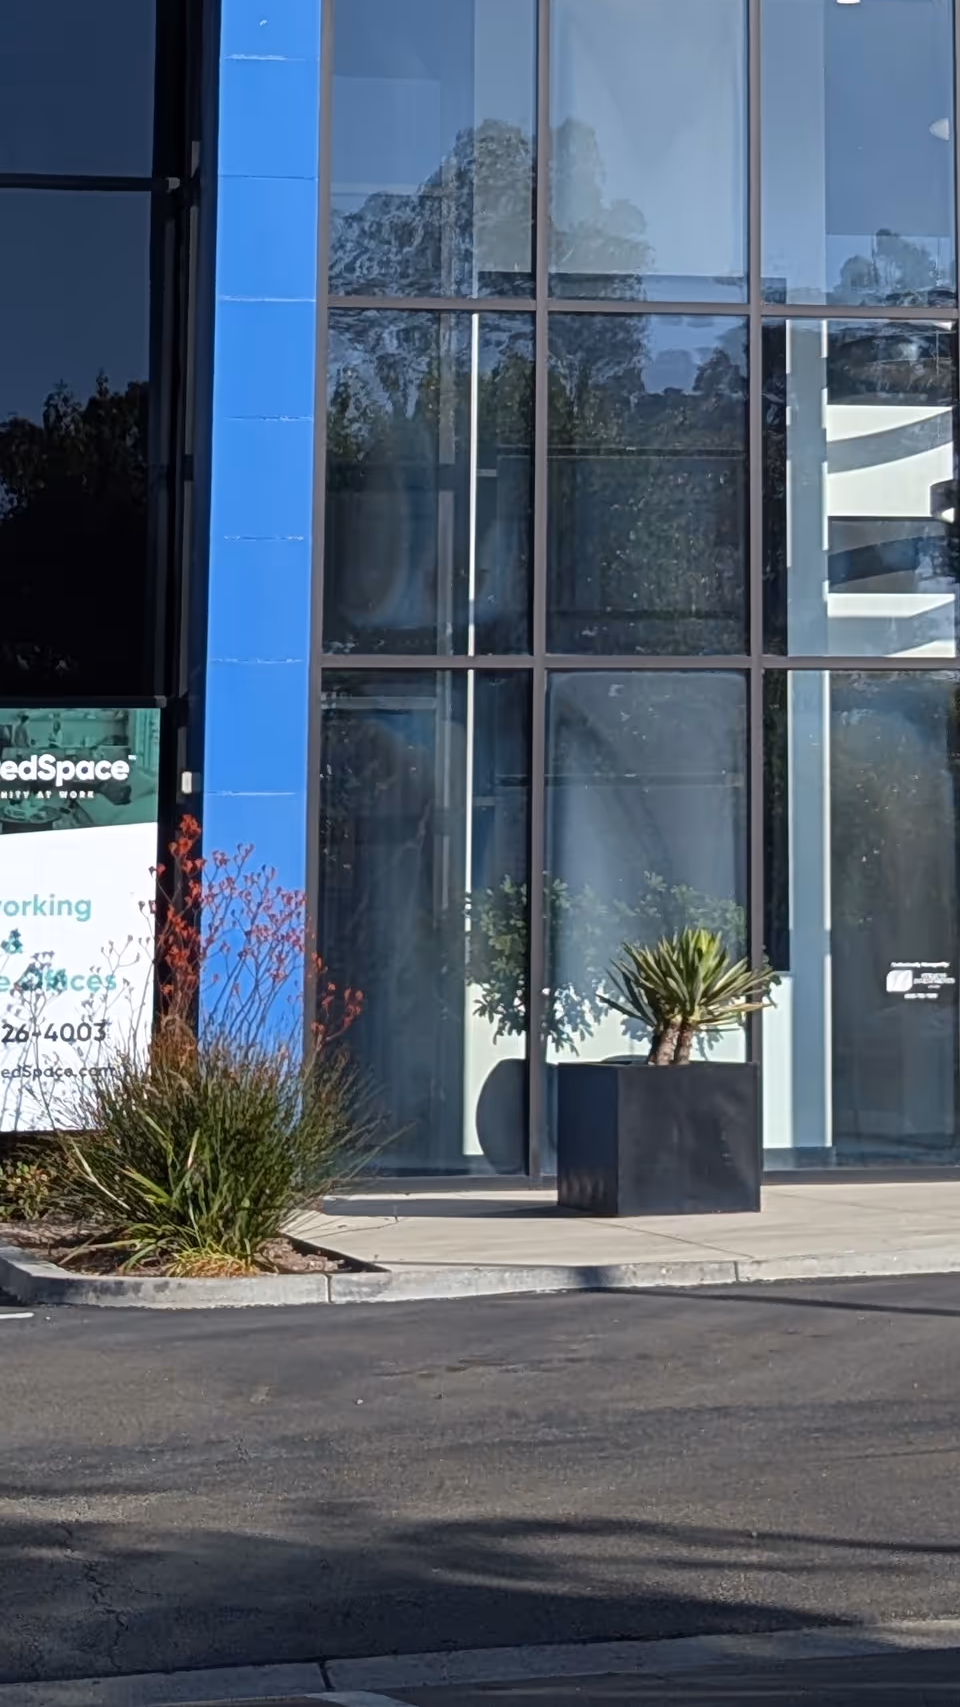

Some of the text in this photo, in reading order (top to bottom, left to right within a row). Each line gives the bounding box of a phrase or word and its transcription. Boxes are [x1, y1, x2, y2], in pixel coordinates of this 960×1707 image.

[36, 790, 52, 799] AT
[59, 790, 95, 799] WORK
[0, 894, 91, 922] orking
